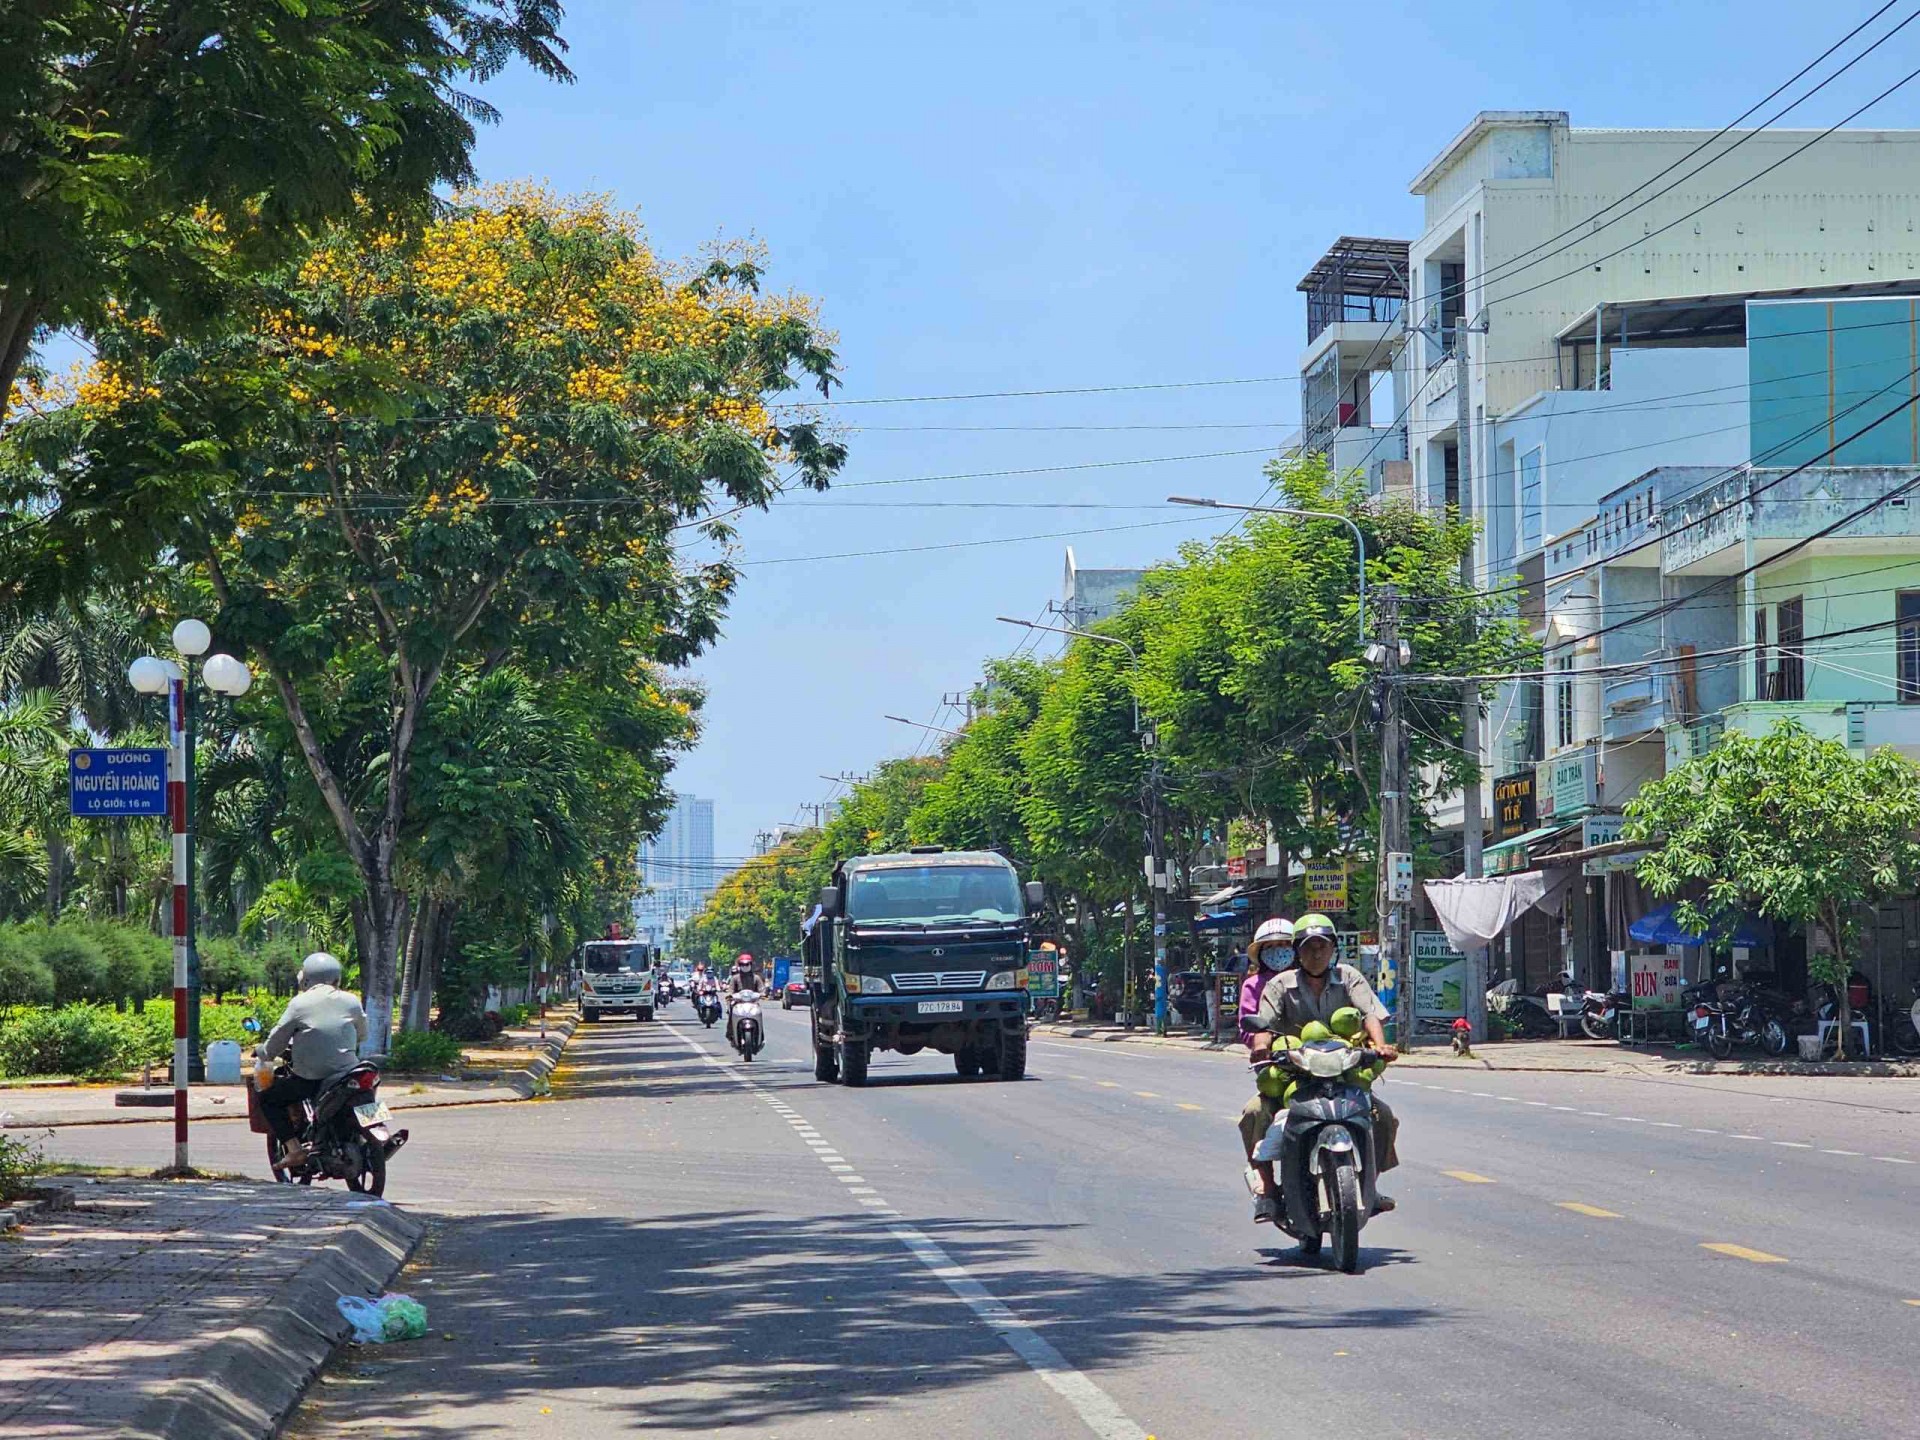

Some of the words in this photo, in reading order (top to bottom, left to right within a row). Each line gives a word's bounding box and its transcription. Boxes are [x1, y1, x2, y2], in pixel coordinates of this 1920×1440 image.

[107, 752, 151, 764] ĐƯỜNG
[75, 770, 119, 791] NGUYỄN
[122, 771, 160, 791] HOÀNG
[88, 798, 100, 810] LỘ
[129, 799, 139, 808] 16
[1634, 964, 1657, 997] BÚN
